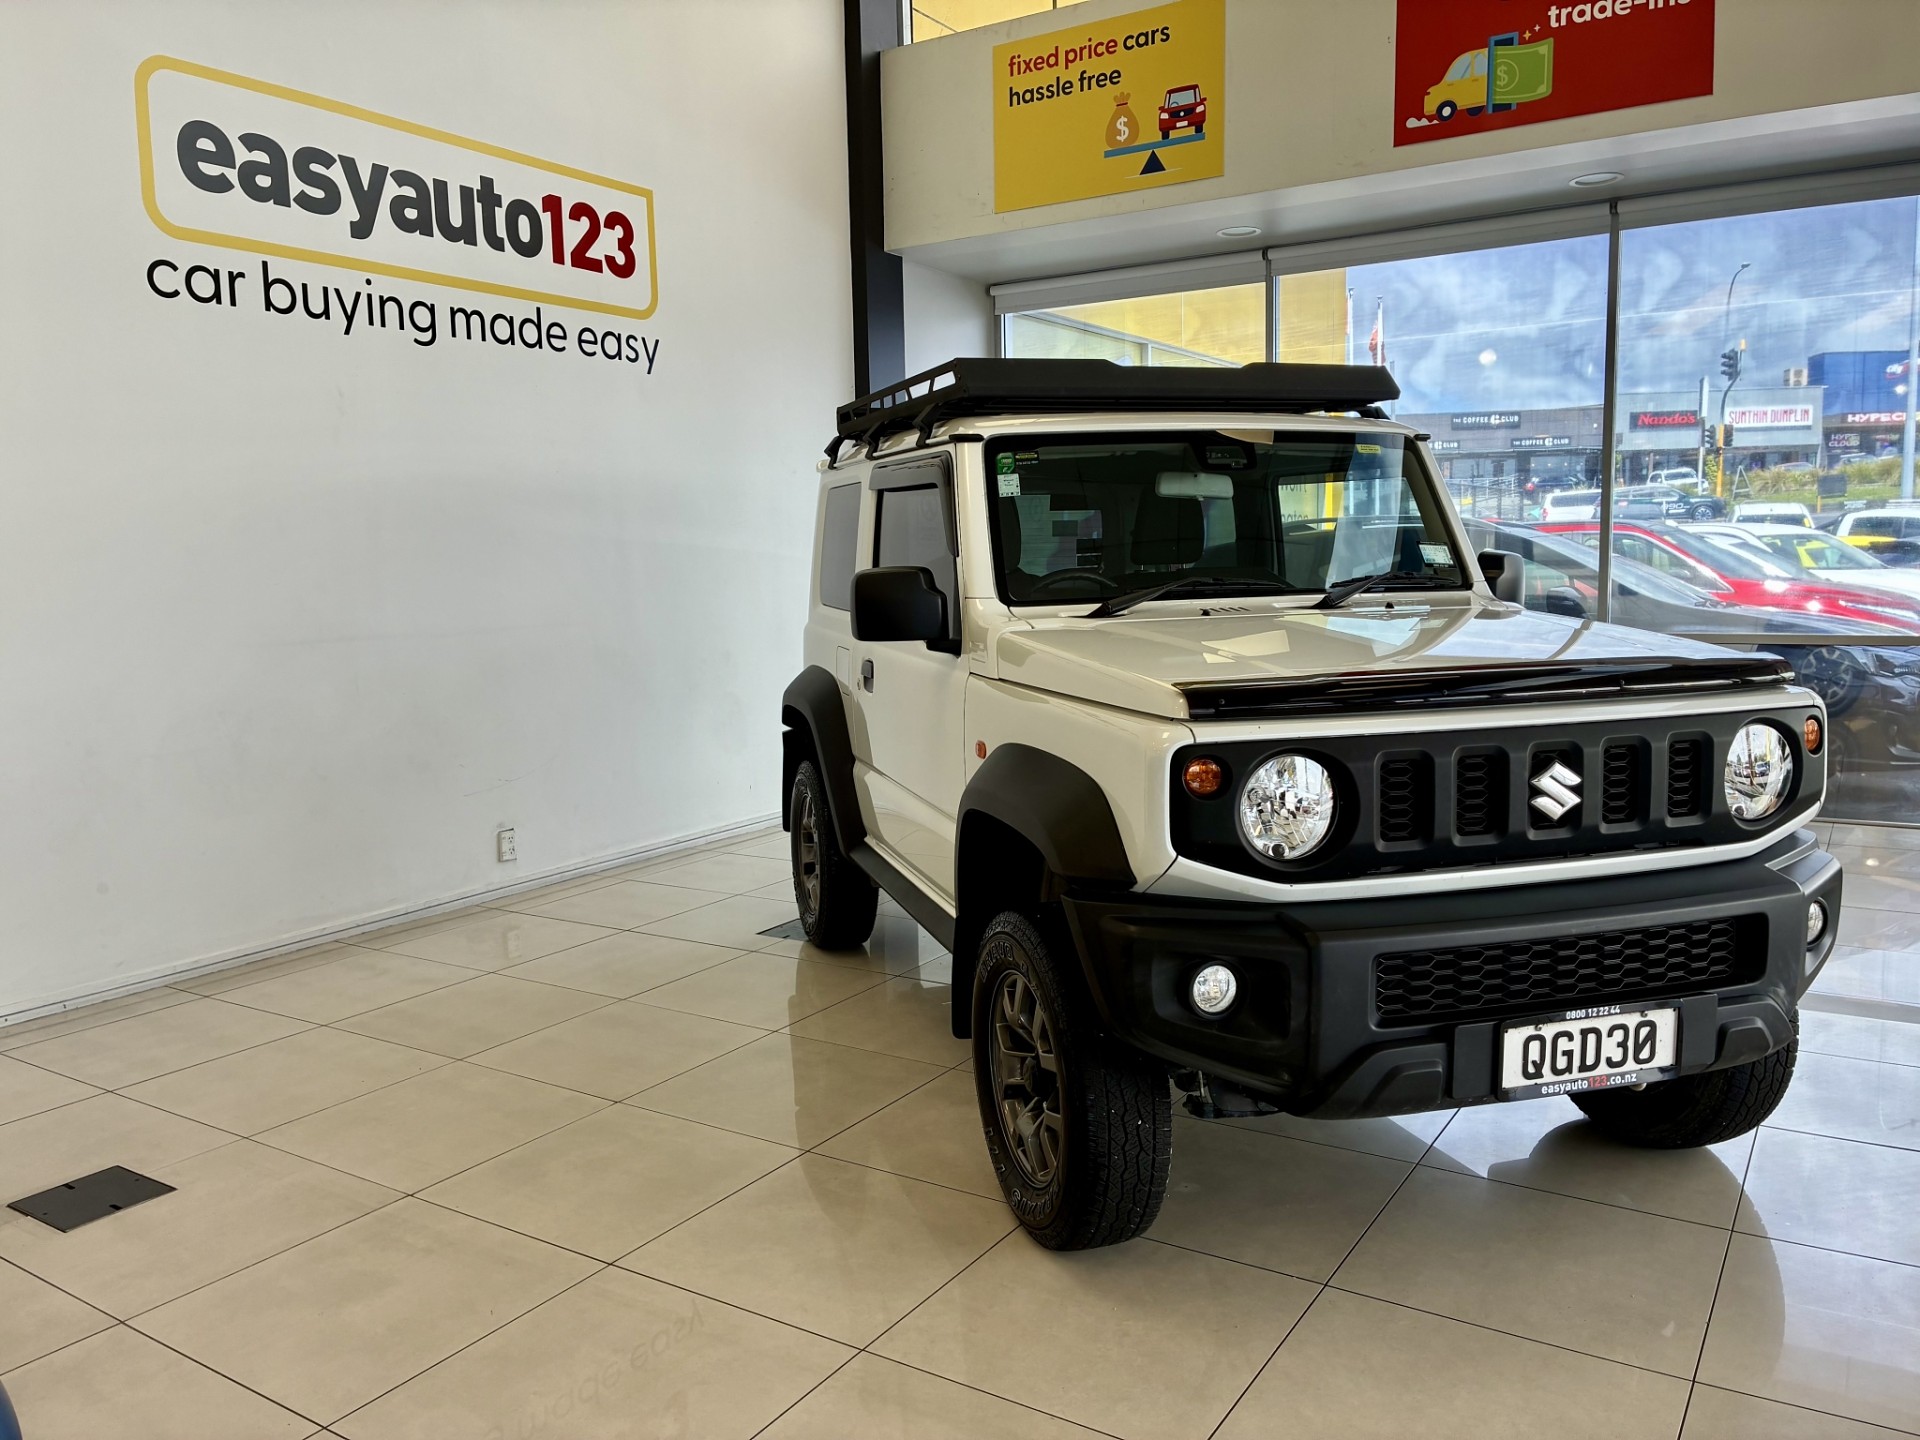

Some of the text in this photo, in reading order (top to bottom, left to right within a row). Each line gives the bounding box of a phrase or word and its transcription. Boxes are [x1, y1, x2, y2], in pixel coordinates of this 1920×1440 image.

[1548, 0, 1691, 28] trade-in
[1008, 26, 1171, 77] fixed price cars
[1009, 69, 1122, 107] hassle free
[177, 119, 636, 279] easyauto123
[146, 258, 660, 375] car buying made easy
[1463, 416, 1488, 424] COFFEE
[1638, 411, 1696, 426] Nando's
[1566, 1005, 1620, 1020] 0800 12 22 44
[1521, 1019, 1657, 1081] QGD30
[1541, 1074, 1637, 1095] easyauto123.co.nz
